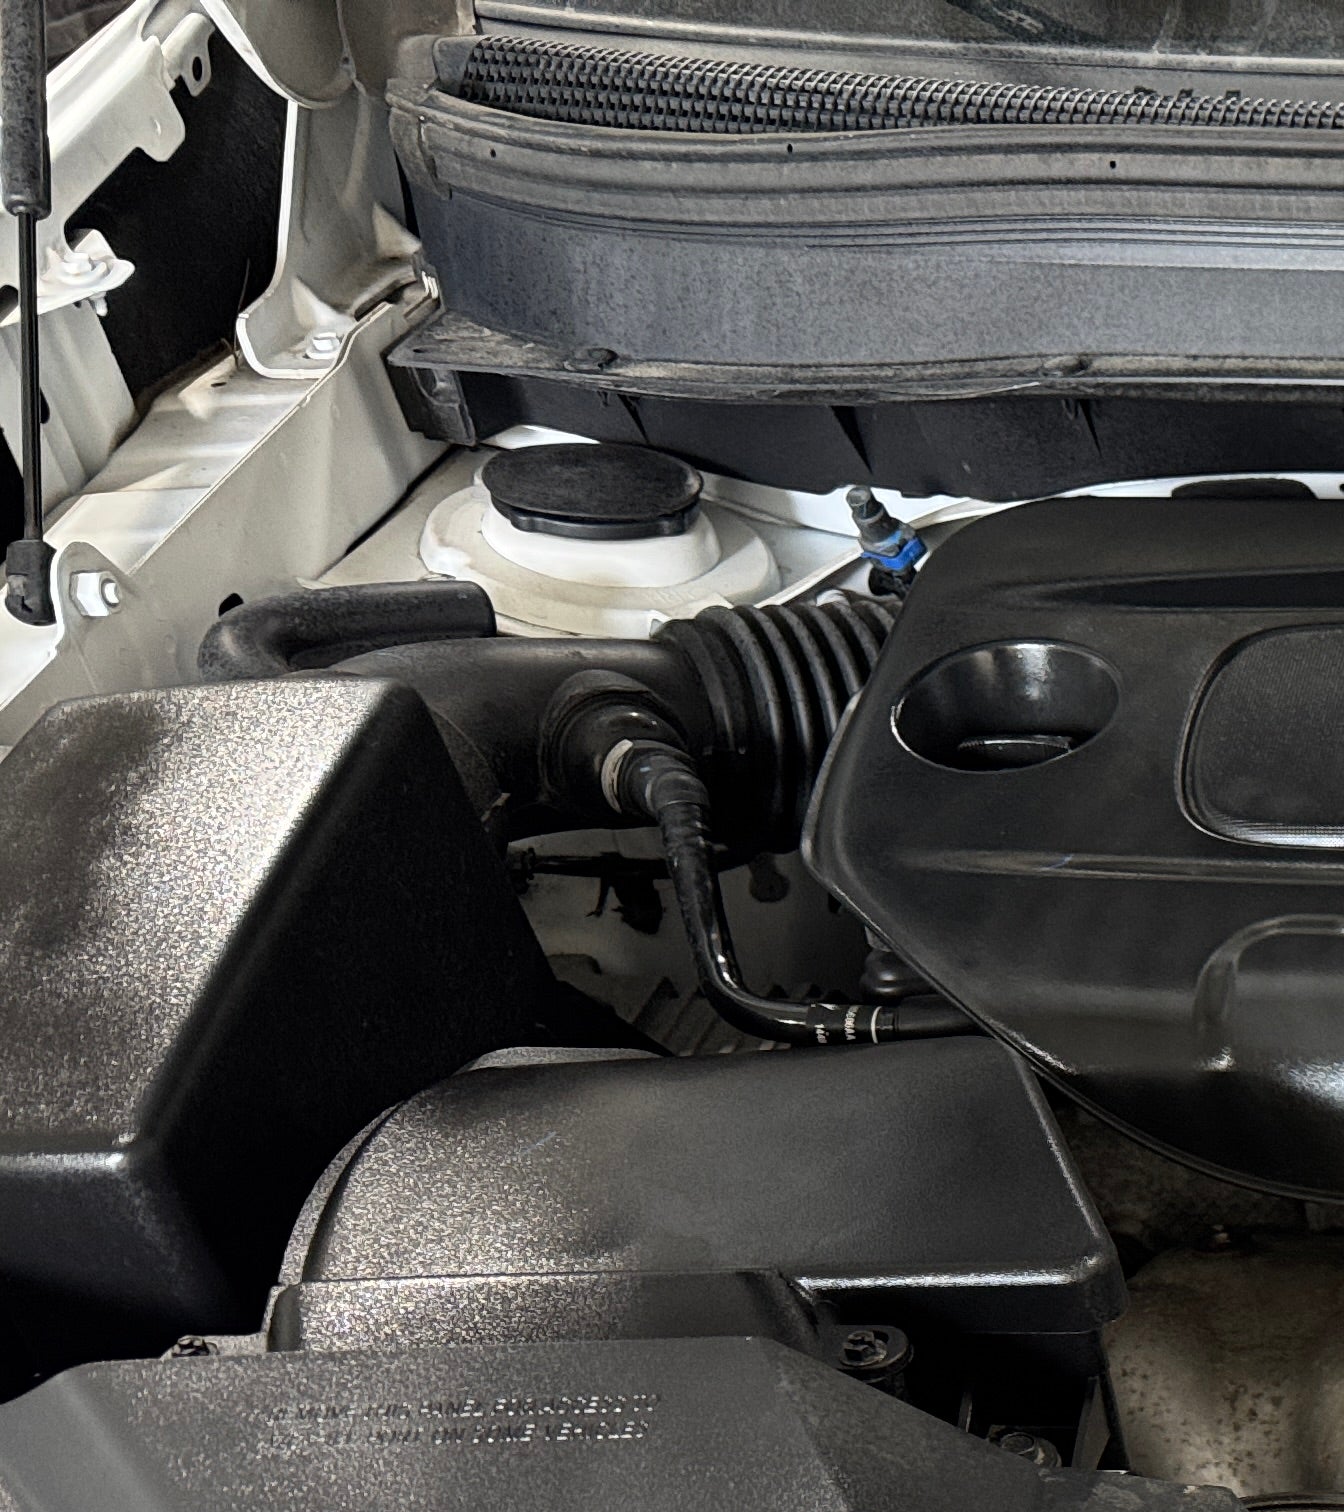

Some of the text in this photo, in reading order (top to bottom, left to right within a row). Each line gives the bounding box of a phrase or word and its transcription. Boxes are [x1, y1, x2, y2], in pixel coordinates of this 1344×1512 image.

[419, 1397, 483, 1419] PANEL
[490, 1397, 534, 1417] FOR
[538, 1395, 624, 1416] ACCESS
[430, 1422, 464, 1445] ON
[472, 1422, 537, 1444] SOME
[541, 1418, 650, 1443] VEHICLES
